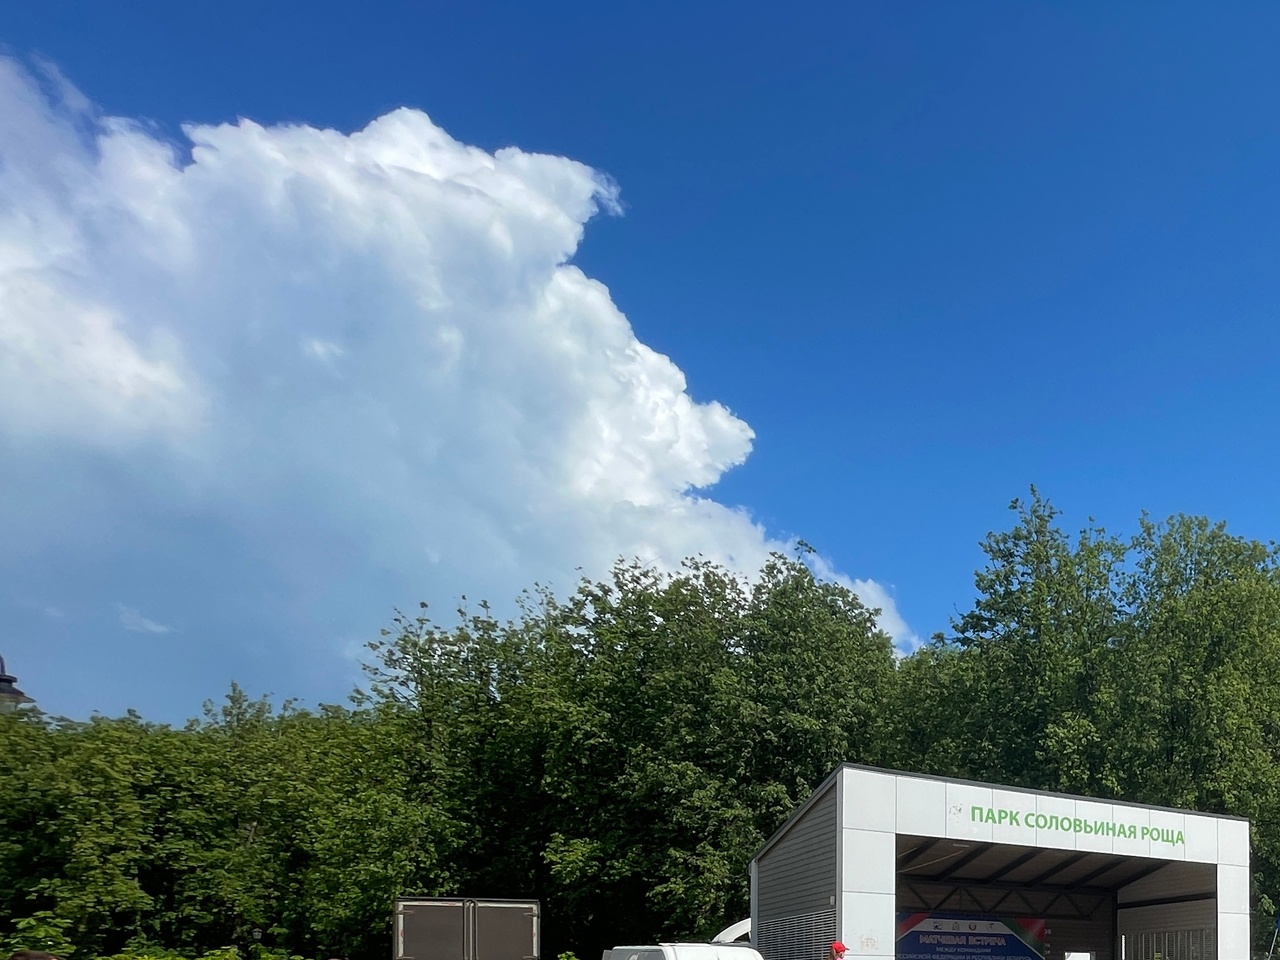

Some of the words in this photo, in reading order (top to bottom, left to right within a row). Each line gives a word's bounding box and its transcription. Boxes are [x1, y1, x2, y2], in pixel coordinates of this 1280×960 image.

[971, 805, 1021, 827] ПАРК
[1024, 812, 1137, 840] СОЛОВЬИНАЯ
[1141, 826, 1185, 847] РОЩА
[919, 934, 967, 945] МАТЧЕВАЯ
[968, 935, 1007, 946] ВСТРЕЧА
